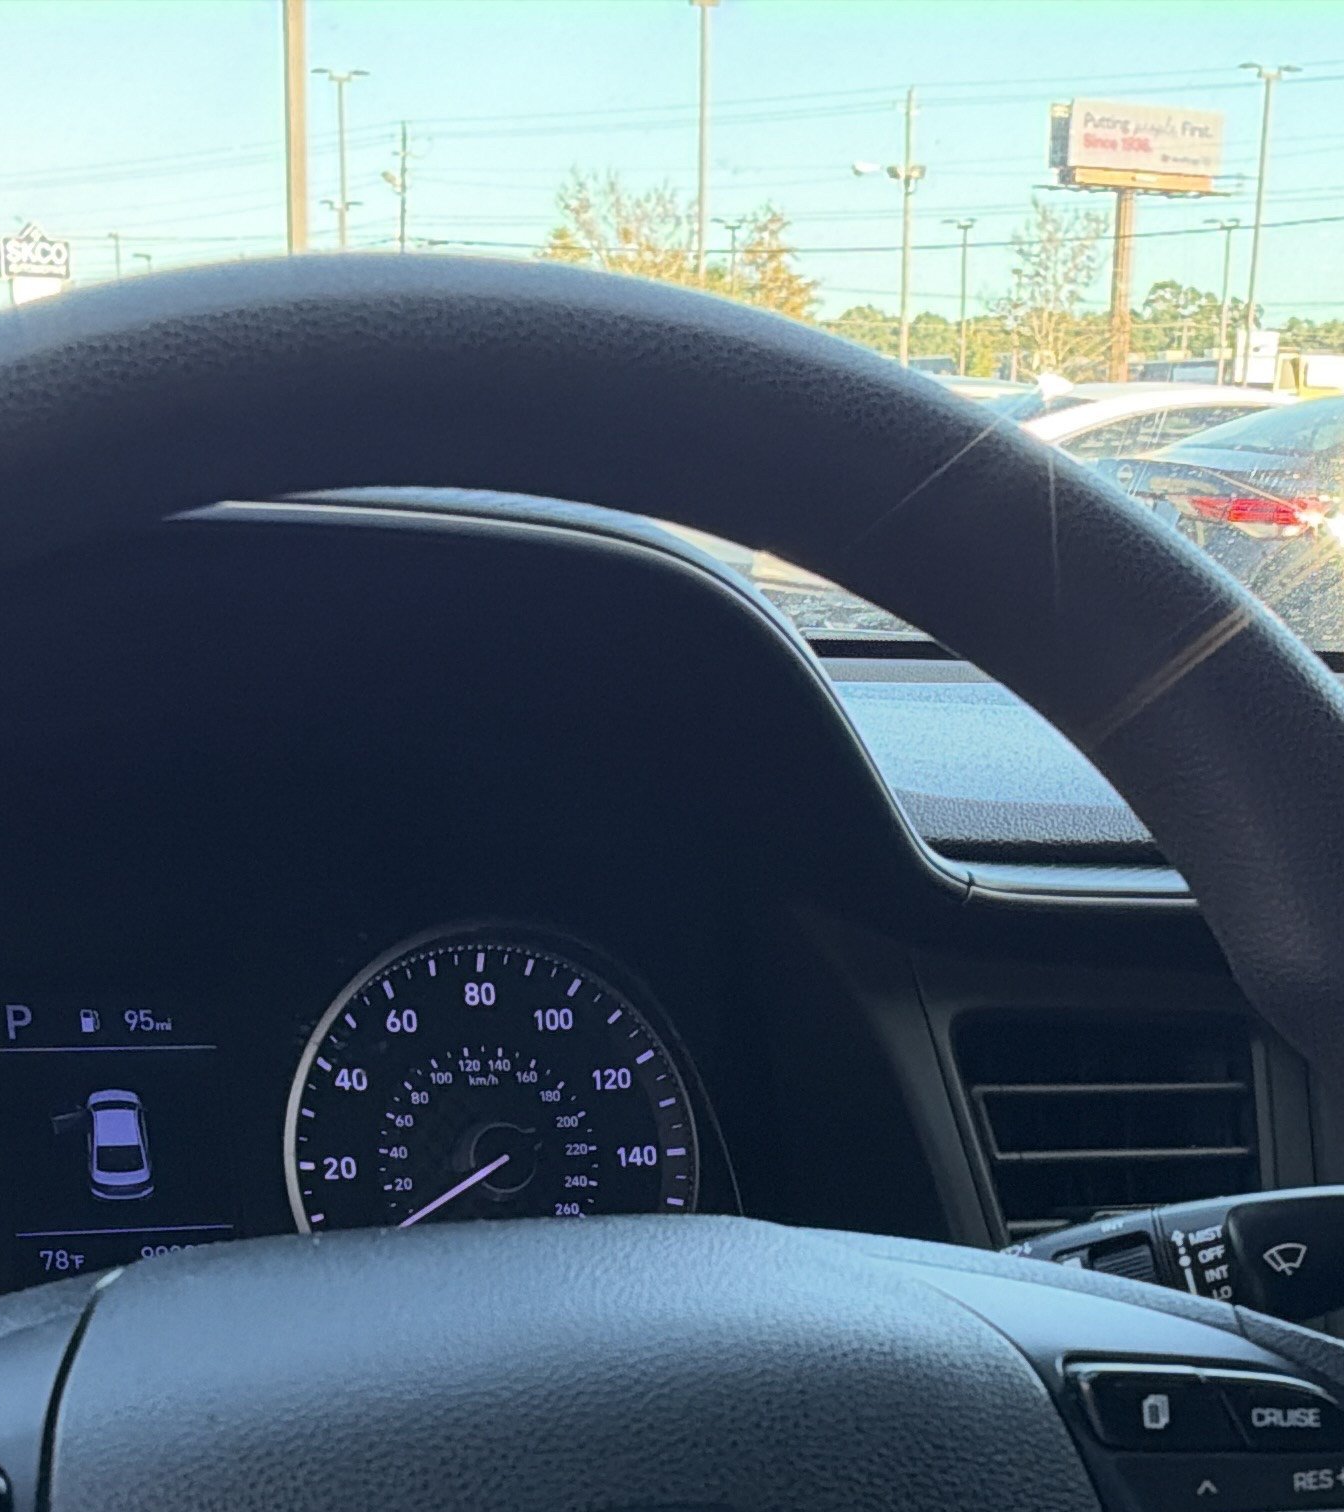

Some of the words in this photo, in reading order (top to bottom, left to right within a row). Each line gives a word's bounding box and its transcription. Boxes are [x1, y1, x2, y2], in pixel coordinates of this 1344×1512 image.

[6, 239, 68, 265] SKCO
[464, 982, 496, 1006] 80
[6, 1004, 32, 1040] P
[386, 1009, 418, 1034] 60
[533, 1008, 574, 1031] 100
[458, 1059, 481, 1073] 120
[487, 1059, 511, 1072] 140
[334, 1067, 367, 1091] 40
[430, 1072, 453, 1086] 100
[468, 1073, 499, 1087] km/h
[515, 1071, 538, 1085] 160
[592, 1068, 632, 1090] 120
[410, 1091, 429, 1105] 80
[539, 1090, 561, 1103] 180
[395, 1114, 414, 1128] 60
[556, 1115, 579, 1128] 200
[389, 1146, 408, 1160] 40
[565, 1143, 588, 1156] 220
[616, 1145, 657, 1167] 140
[323, 1156, 356, 1180] 20
[394, 1178, 413, 1191] 20
[564, 1175, 588, 1188] 240
[555, 1202, 580, 1217] 260
[1197, 1244, 1226, 1264] OFF
[1204, 1264, 1229, 1284] INT
[1251, 1406, 1322, 1429] CRUISE
